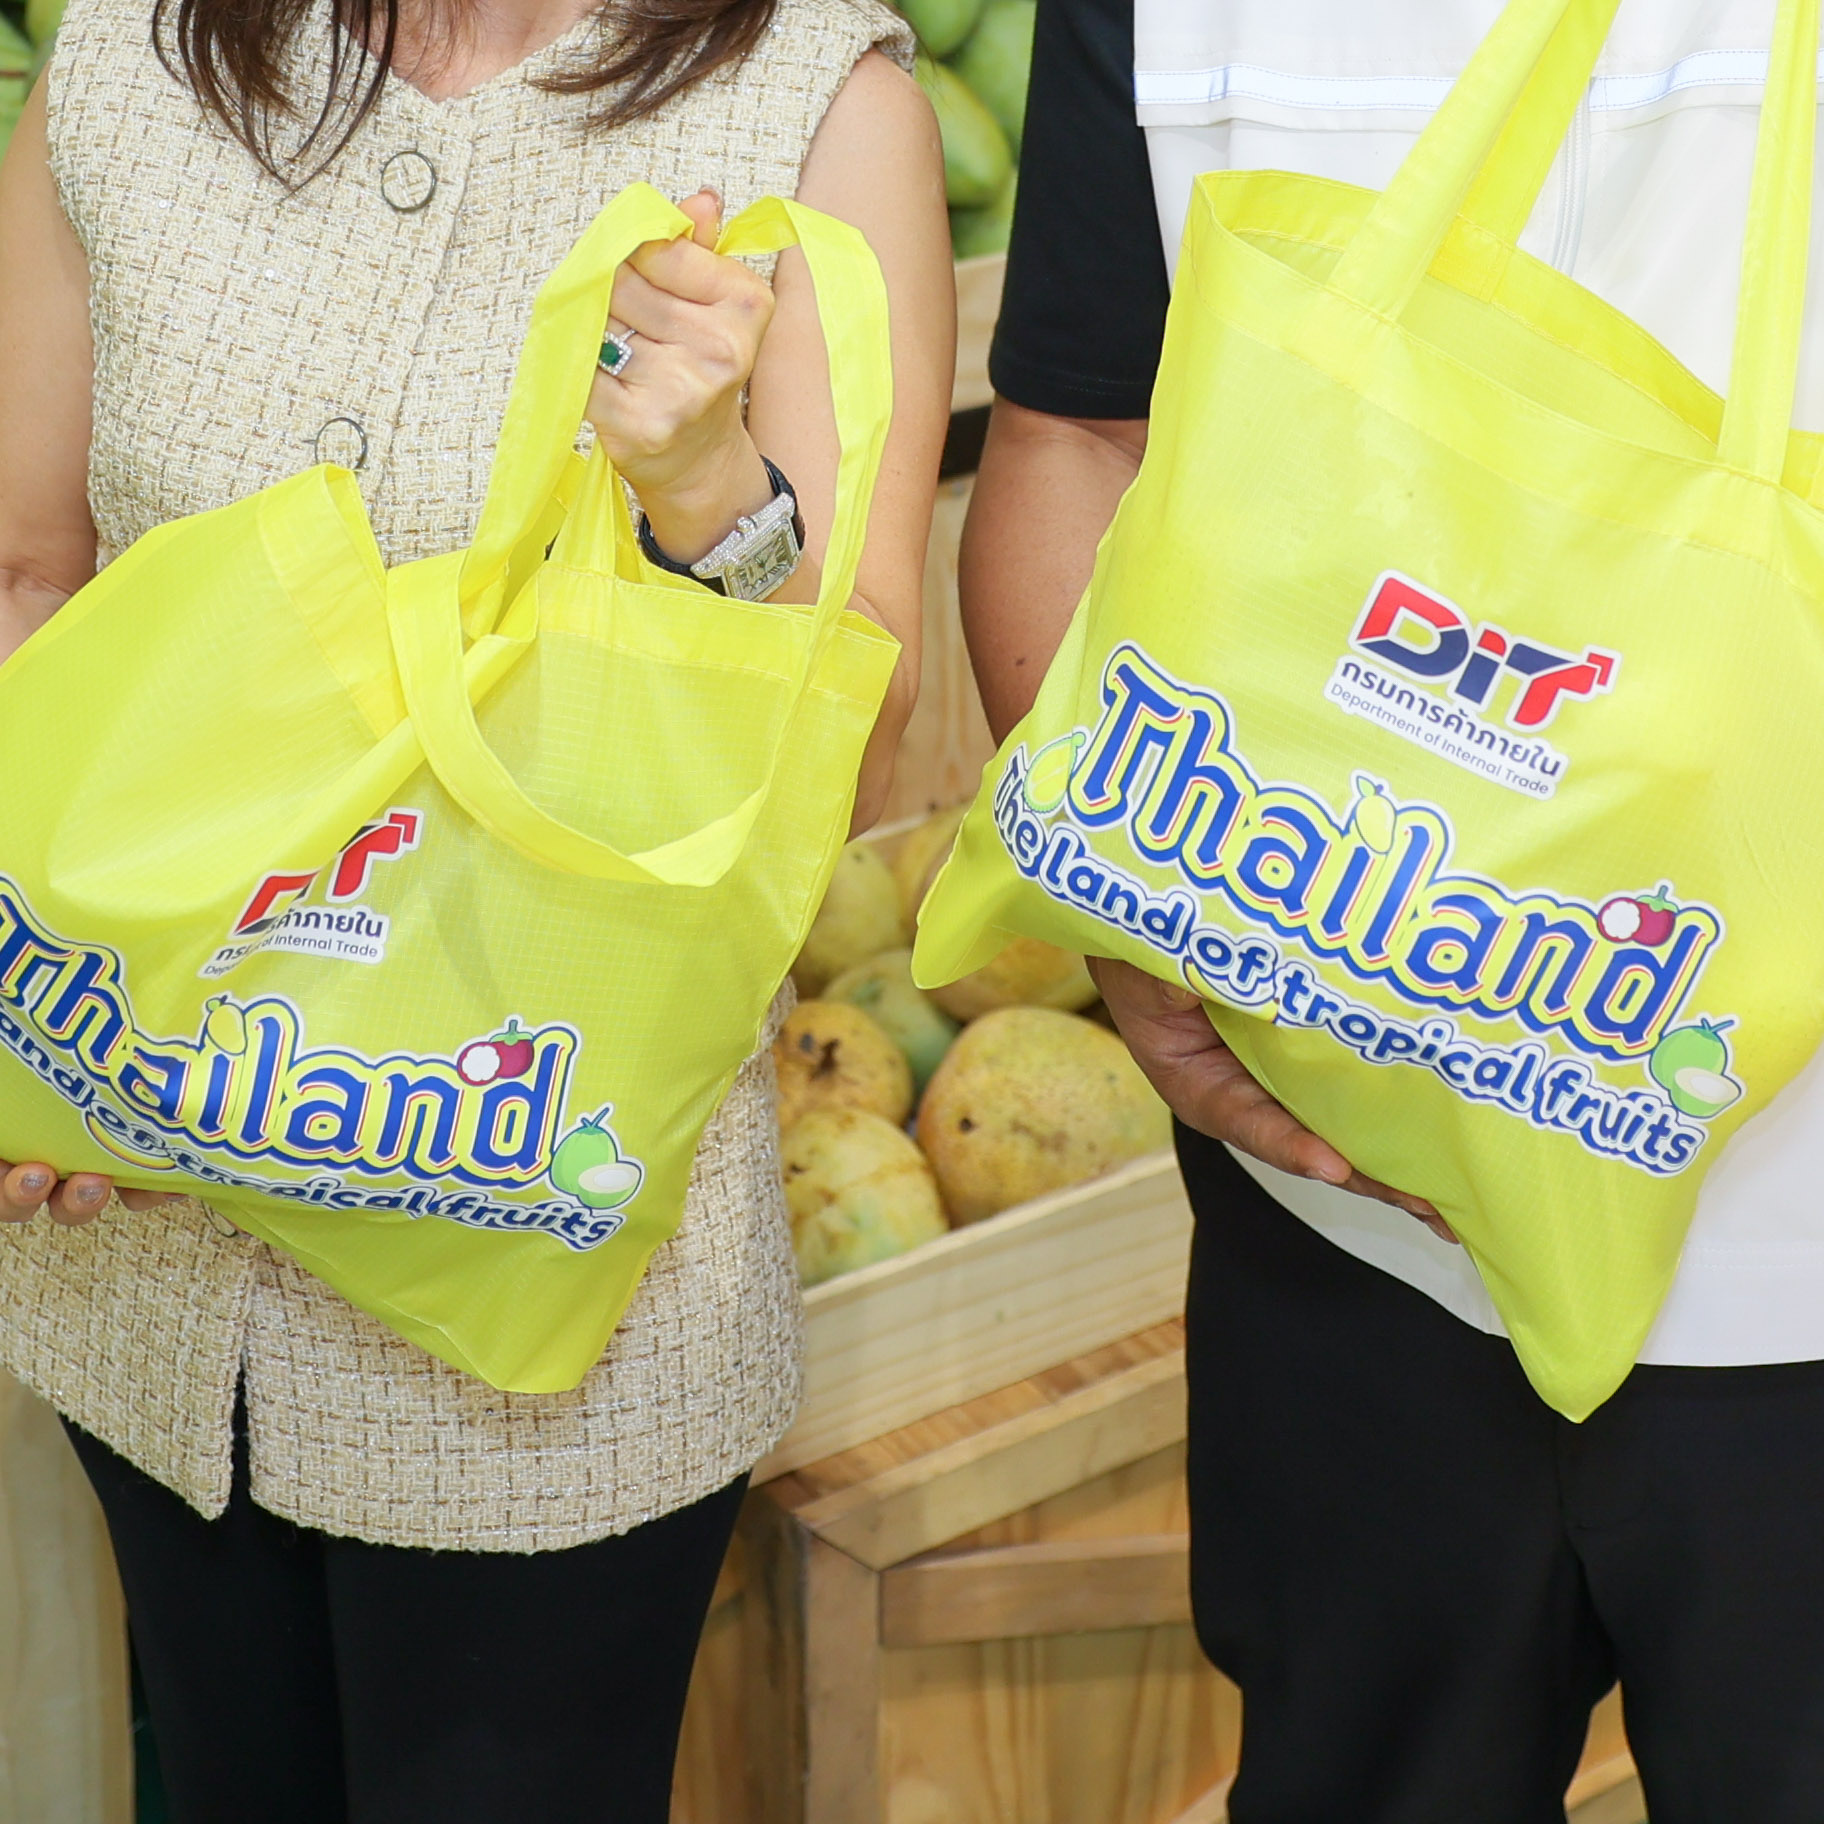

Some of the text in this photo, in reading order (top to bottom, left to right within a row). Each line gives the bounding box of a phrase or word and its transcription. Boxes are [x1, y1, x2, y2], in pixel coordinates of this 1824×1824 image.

[1329, 682, 1551, 796] Department of Internal Trade
[1341, 661, 1562, 777] กรมการค้าภายใน
[1073, 653, 1717, 1056] Thailand
[275, 933, 333, 951] Internal
[335, 940, 378, 958] Trade
[1040, 832, 1191, 950] land
[1190, 930, 1276, 994] of
[1280, 964, 1542, 1108] tropical
[1538, 1062, 1702, 1170] fruits
[93, 1102, 167, 1154] of
[430, 1190, 622, 1249] fruits
